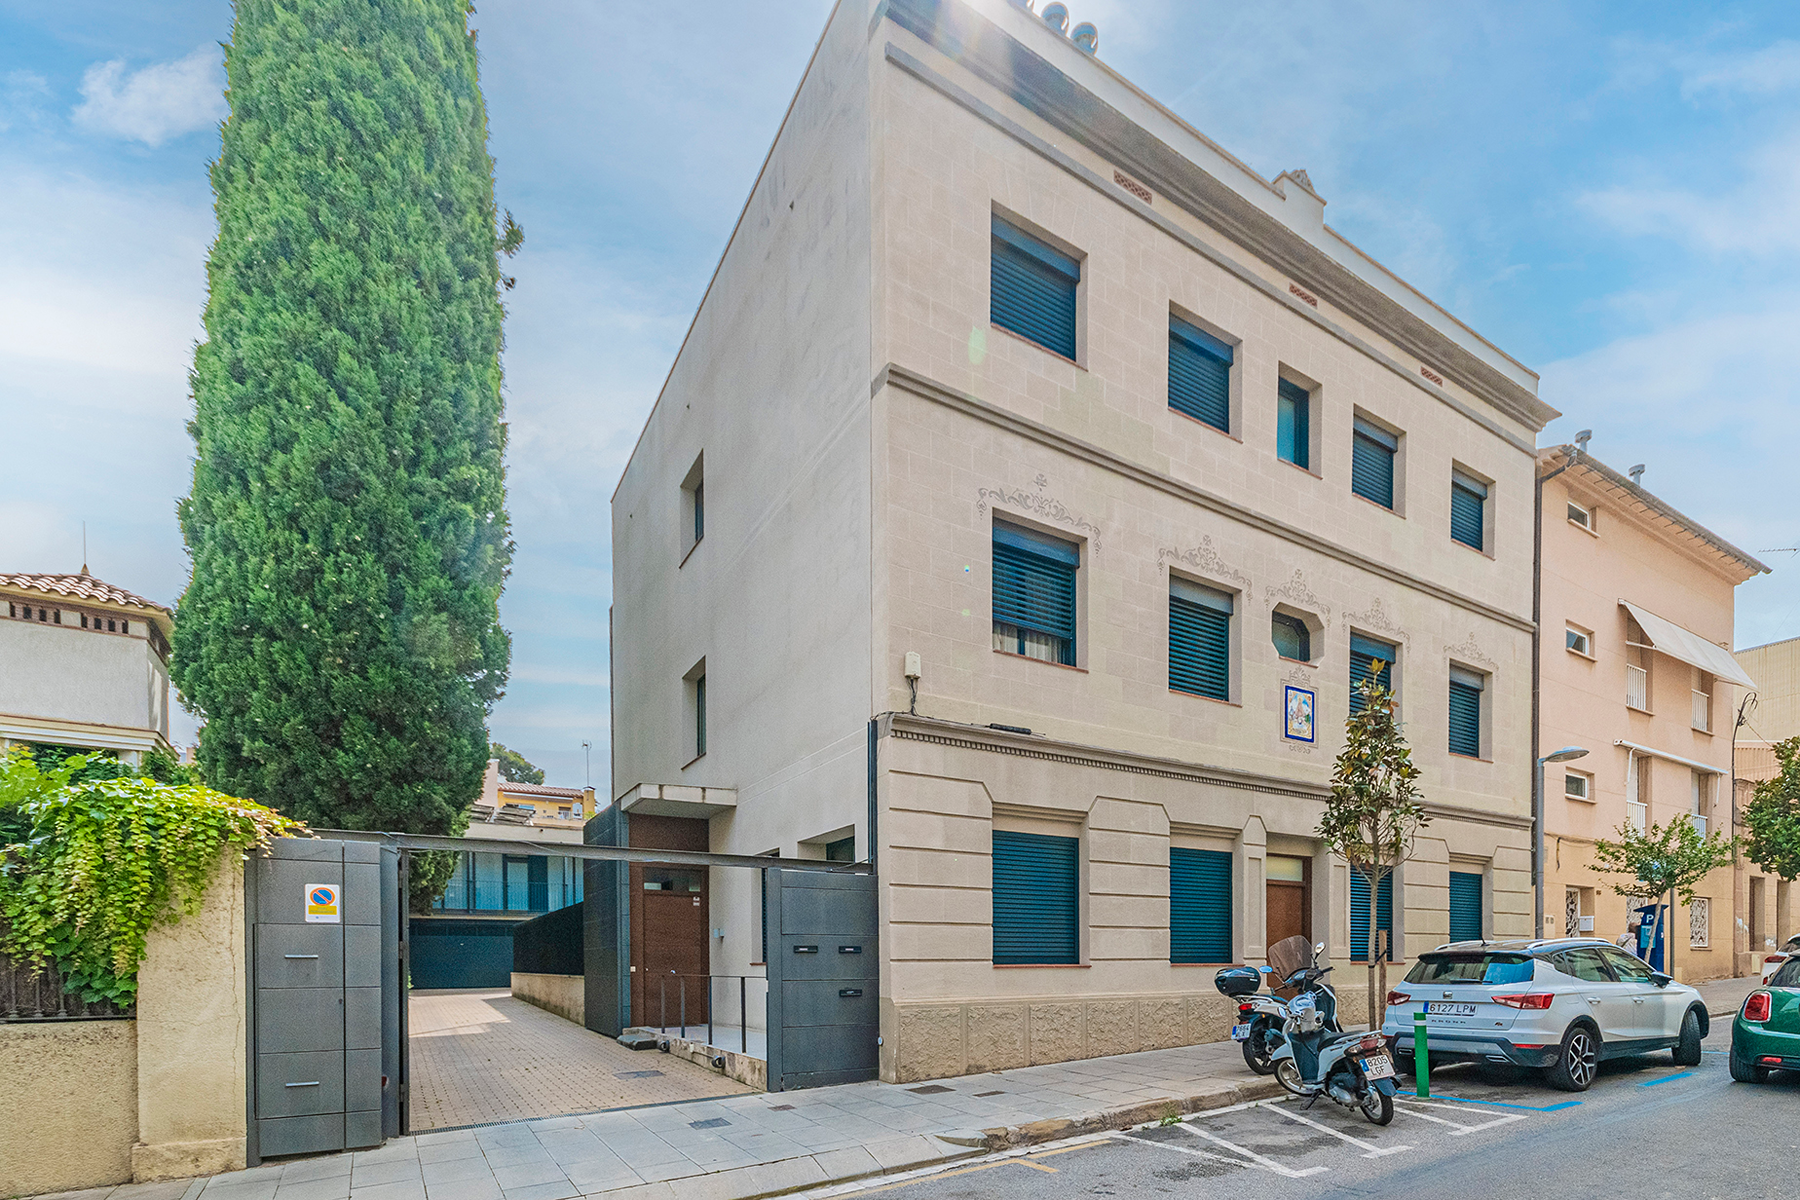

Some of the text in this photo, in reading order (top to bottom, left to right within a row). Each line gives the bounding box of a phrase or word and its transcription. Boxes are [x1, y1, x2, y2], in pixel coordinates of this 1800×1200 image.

[1646, 914, 1654, 923] P
[1429, 1003, 1476, 1013] 6127 LPM
[1366, 1056, 1388, 1067] 8205
[1370, 1065, 1385, 1076] LGF
